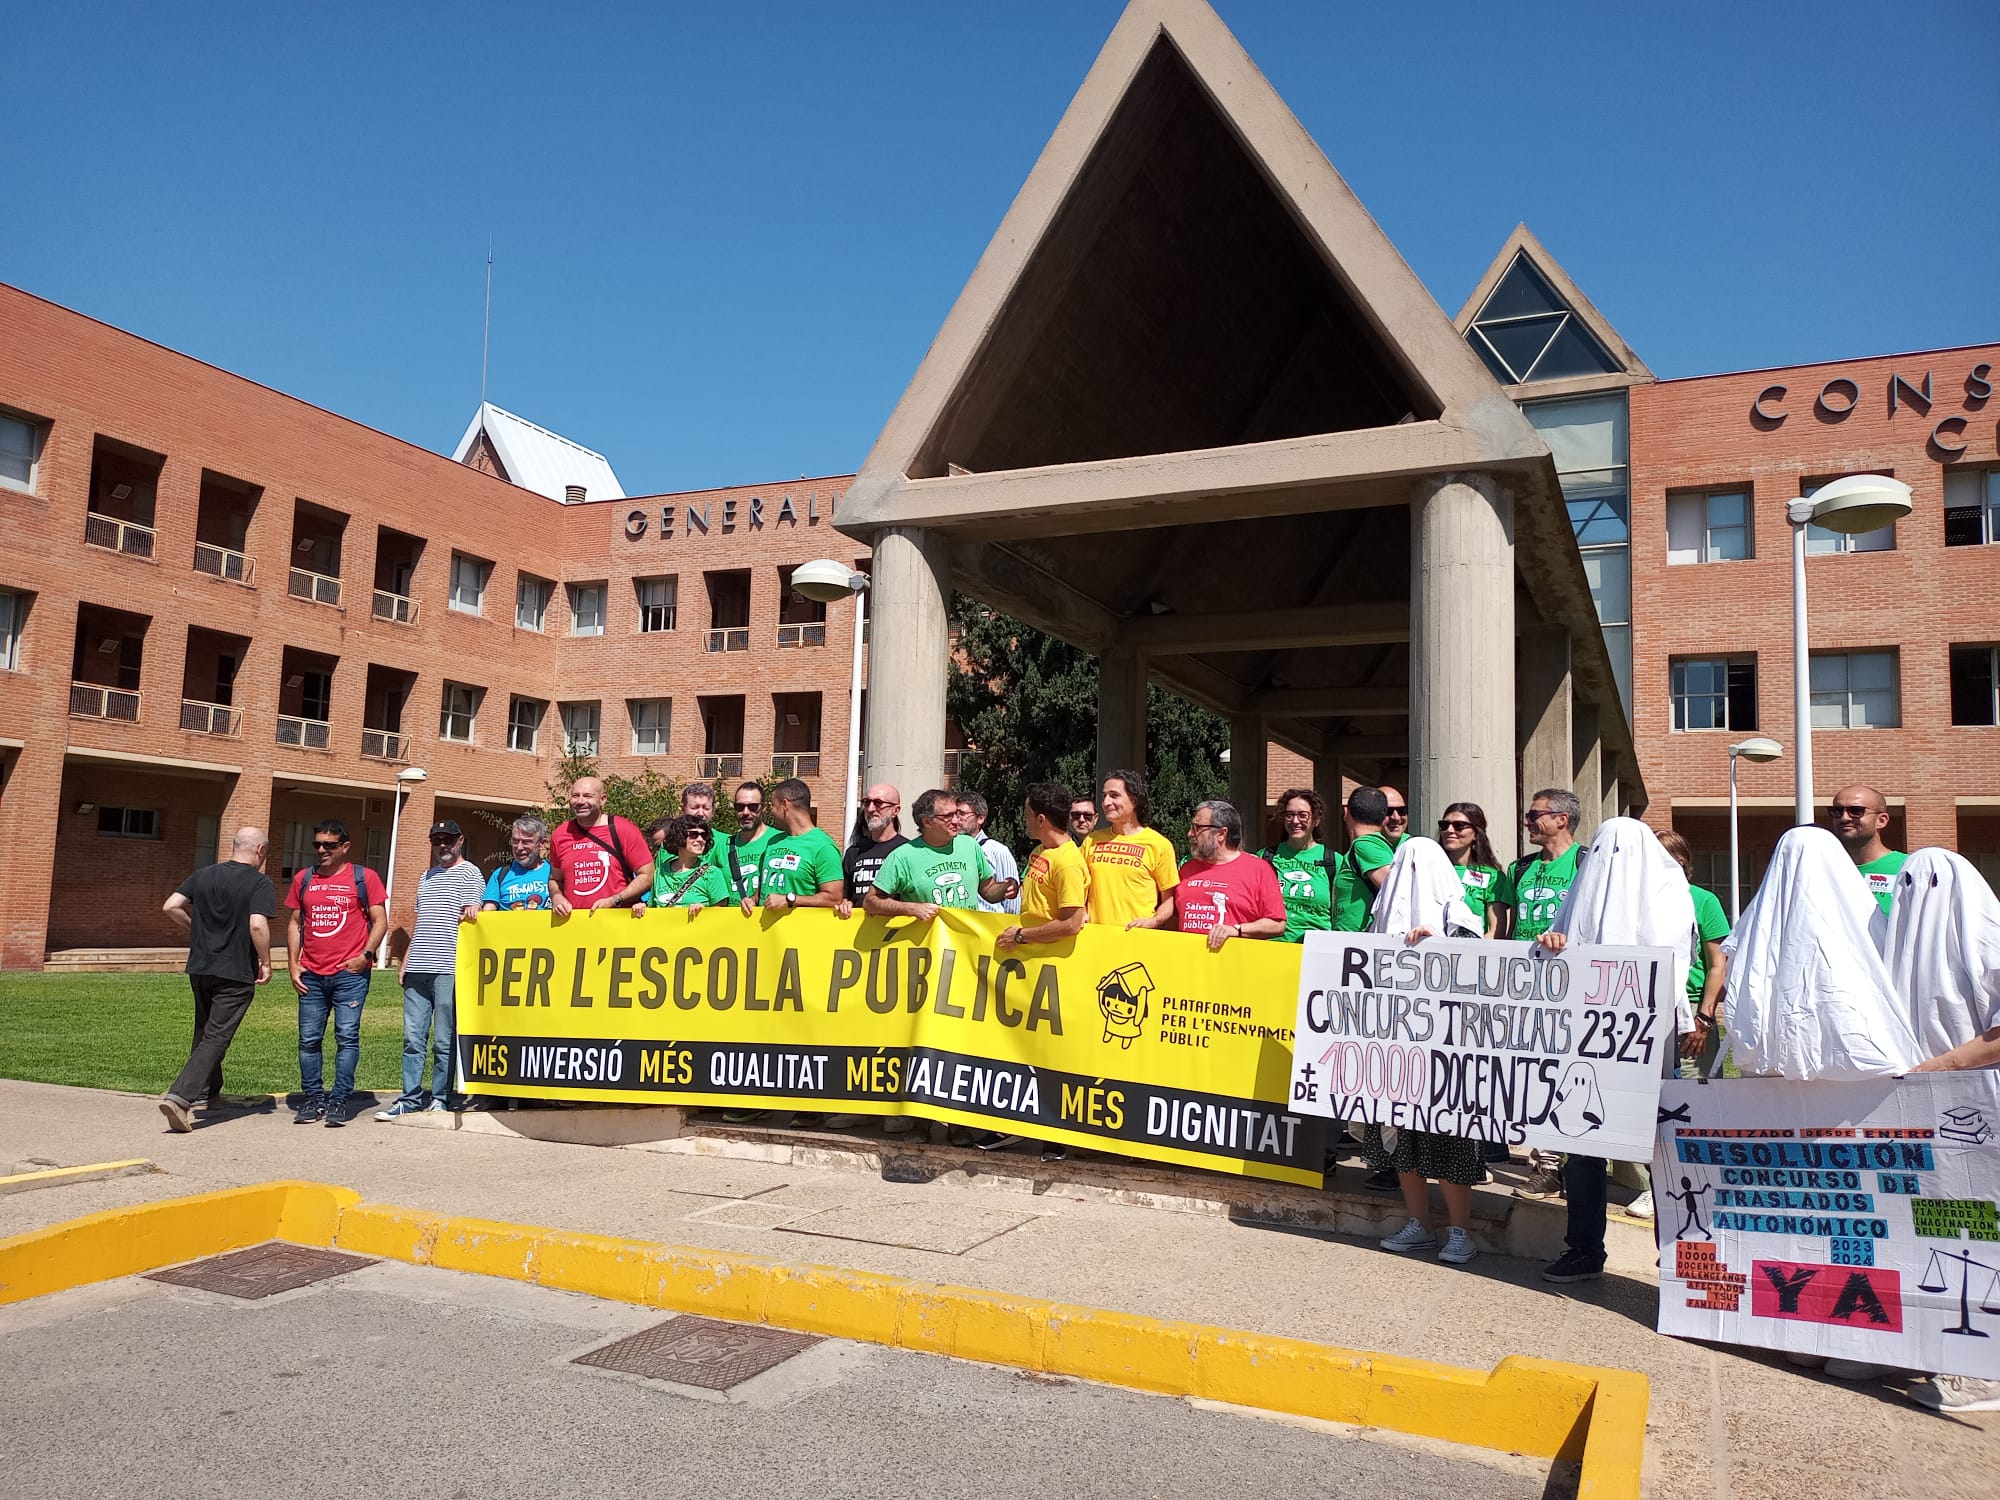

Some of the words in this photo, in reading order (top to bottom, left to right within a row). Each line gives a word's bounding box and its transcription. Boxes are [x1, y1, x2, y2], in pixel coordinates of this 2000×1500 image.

[1755, 362, 1994, 420] CONS
[853, 868, 880, 882] PÚBL
[925, 862, 967, 877] ESTIMEM
[1185, 902, 1216, 911] Salvem
[1184, 911, 1215, 921] l'escola
[311, 919, 338, 928] pública
[1183, 920, 1213, 931] pública
[477, 948, 555, 1007] PER
[570, 947, 805, 1012] L'ESCOLA
[827, 928, 1063, 1036] PÚBLICA
[1163, 996, 1252, 1019] PLATAFORMA
[1161, 1014, 1187, 1029] PER
[1306, 990, 1434, 1042] CONCURS
[1439, 1000, 1572, 1055] TRASLLATS
[1577, 1009, 1658, 1065] 23-24
[1159, 1028, 1210, 1048] PÚBLIC
[1318, 1041, 1426, 1105] 10000
[1430, 1049, 1560, 1126] DOCENTS
[471, 1036, 508, 1078] MÉS
[520, 1040, 623, 1082] INVERSIÓ
[639, 1041, 693, 1085] MÉS
[710, 1051, 828, 1090] QUALITAT
[846, 1047, 901, 1093] MÉS
[1060, 1077, 1125, 1130] MÉS
[1146, 1096, 1301, 1158] DIGNITAT
[1294, 1082, 1318, 1102] DE
[1676, 1128, 1795, 1138] PARALIZADO
[1804, 1129, 1853, 1138] DESDE
[1866, 1129, 1935, 1138] ENERO
[1683, 1139, 1926, 1170] RESOLUCIÓN
[1723, 1168, 1859, 1189] CONCURSO
[1882, 1175, 1918, 1194] DE
[1717, 1190, 1868, 1211] TRASLADOS
[1921, 1199, 1986, 1210] CONSELLER
[1717, 1212, 1887, 1239] AUTONÓMICO
[1831, 1239, 1873, 1252] 2023
[1678, 1250, 1716, 1261] 10000
[1831, 1253, 1873, 1266] 2024
[1677, 1261, 1728, 1272] DOCENTES
[1678, 1270, 1747, 1284] VALENCIANOS
[1687, 1281, 1745, 1294] AFECTADOS
[1688, 1300, 1739, 1312] FAMILIAS
